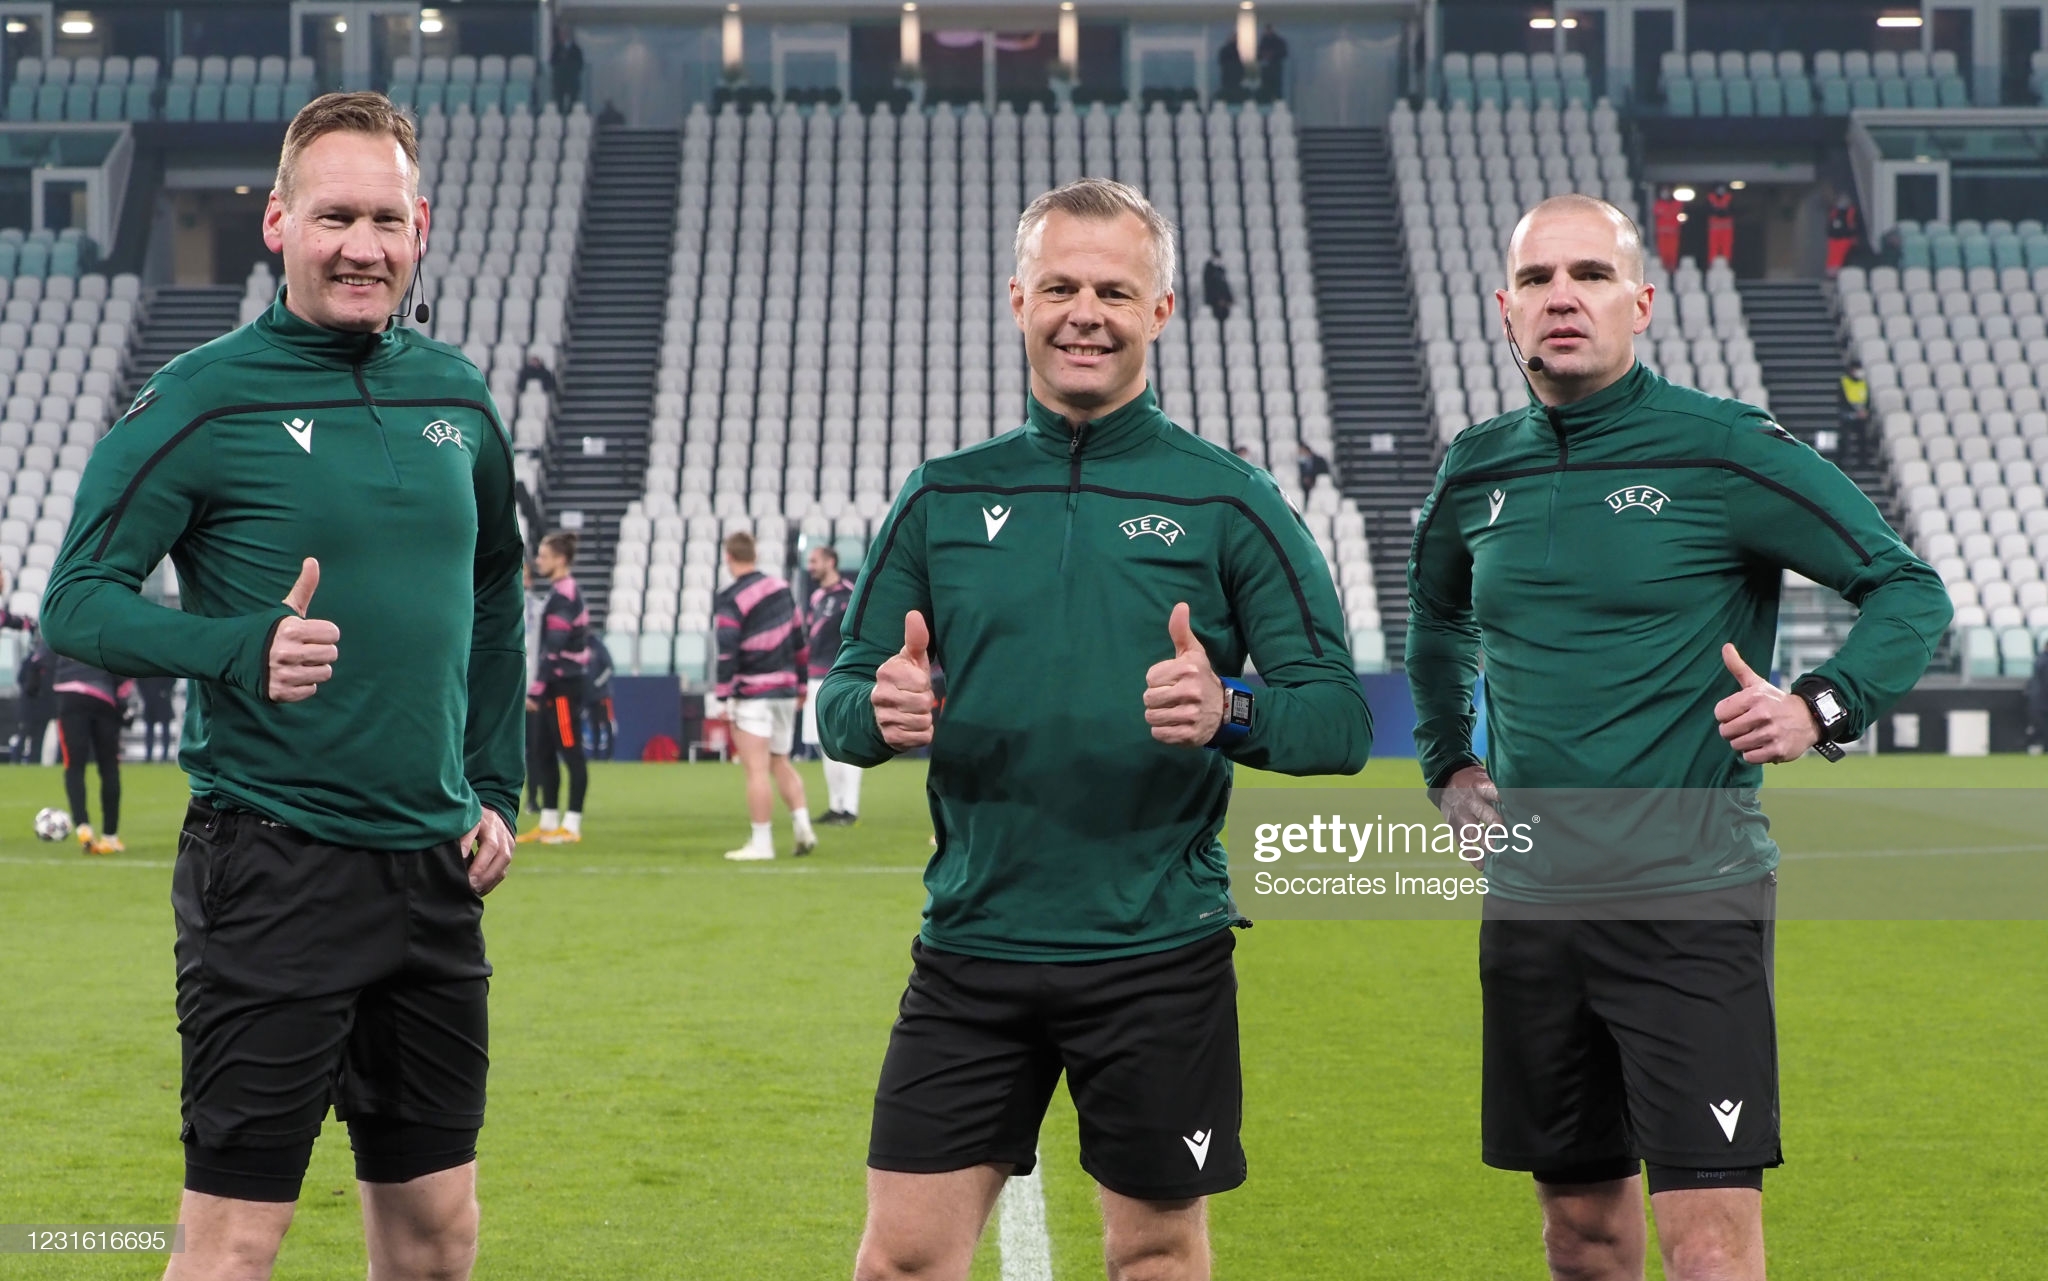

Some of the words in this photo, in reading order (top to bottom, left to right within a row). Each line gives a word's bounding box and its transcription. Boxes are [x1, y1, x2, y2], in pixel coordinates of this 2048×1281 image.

[425, 424, 461, 445] UEFA
[1608, 490, 1664, 512] UEFA
[1122, 519, 1179, 543] UEFA
